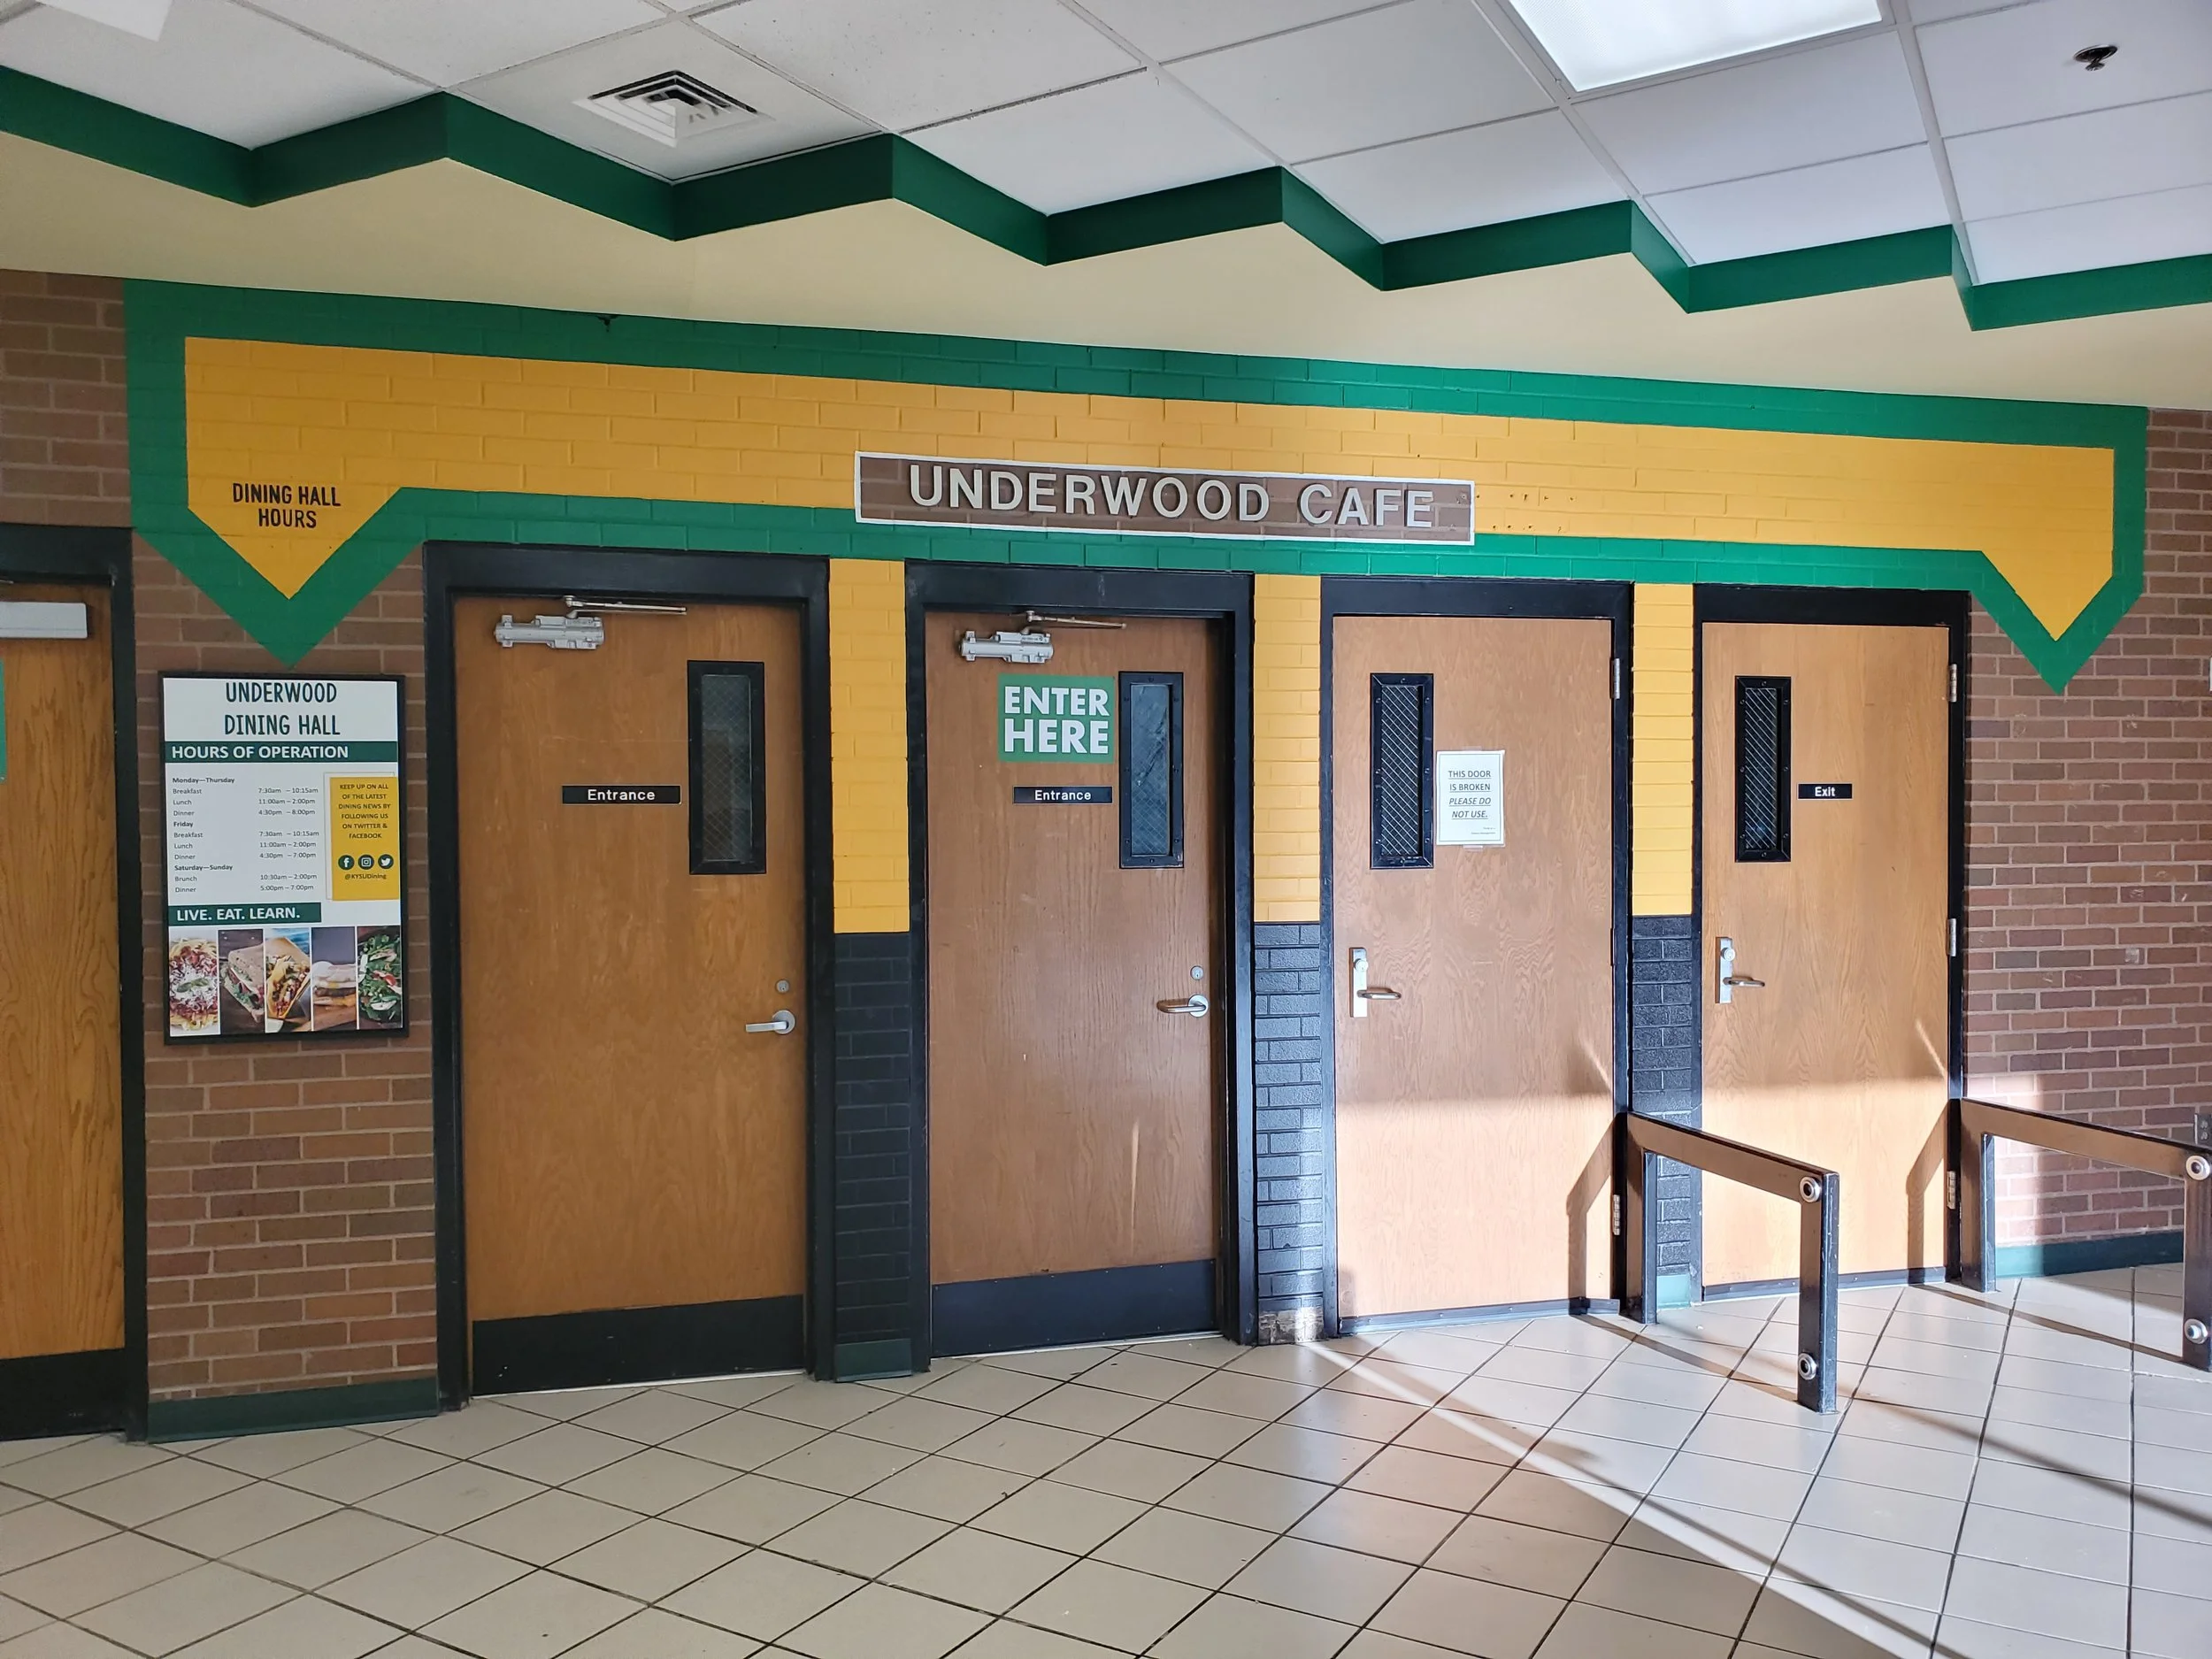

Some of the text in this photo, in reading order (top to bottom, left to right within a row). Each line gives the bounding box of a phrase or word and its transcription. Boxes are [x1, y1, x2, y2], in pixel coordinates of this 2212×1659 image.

[233, 483, 342, 506] DINING HALL
[908, 464, 1434, 528] UNDERWOOD CAFE
[258, 508, 317, 528] HOURS
[226, 682, 337, 703] UNDERWOOD
[1004, 686, 1110, 717] ENTER
[225, 714, 341, 735] DINING HALL
[1004, 718, 1109, 754] HERE
[172, 746, 349, 759] HOURS OF OPERATION
[587, 788, 656, 801] Entrance
[1034, 789, 1092, 801] Entrance
[1815, 786, 1836, 796] Exit
[177, 907, 301, 921] LIVE. EAT. LEARN.
